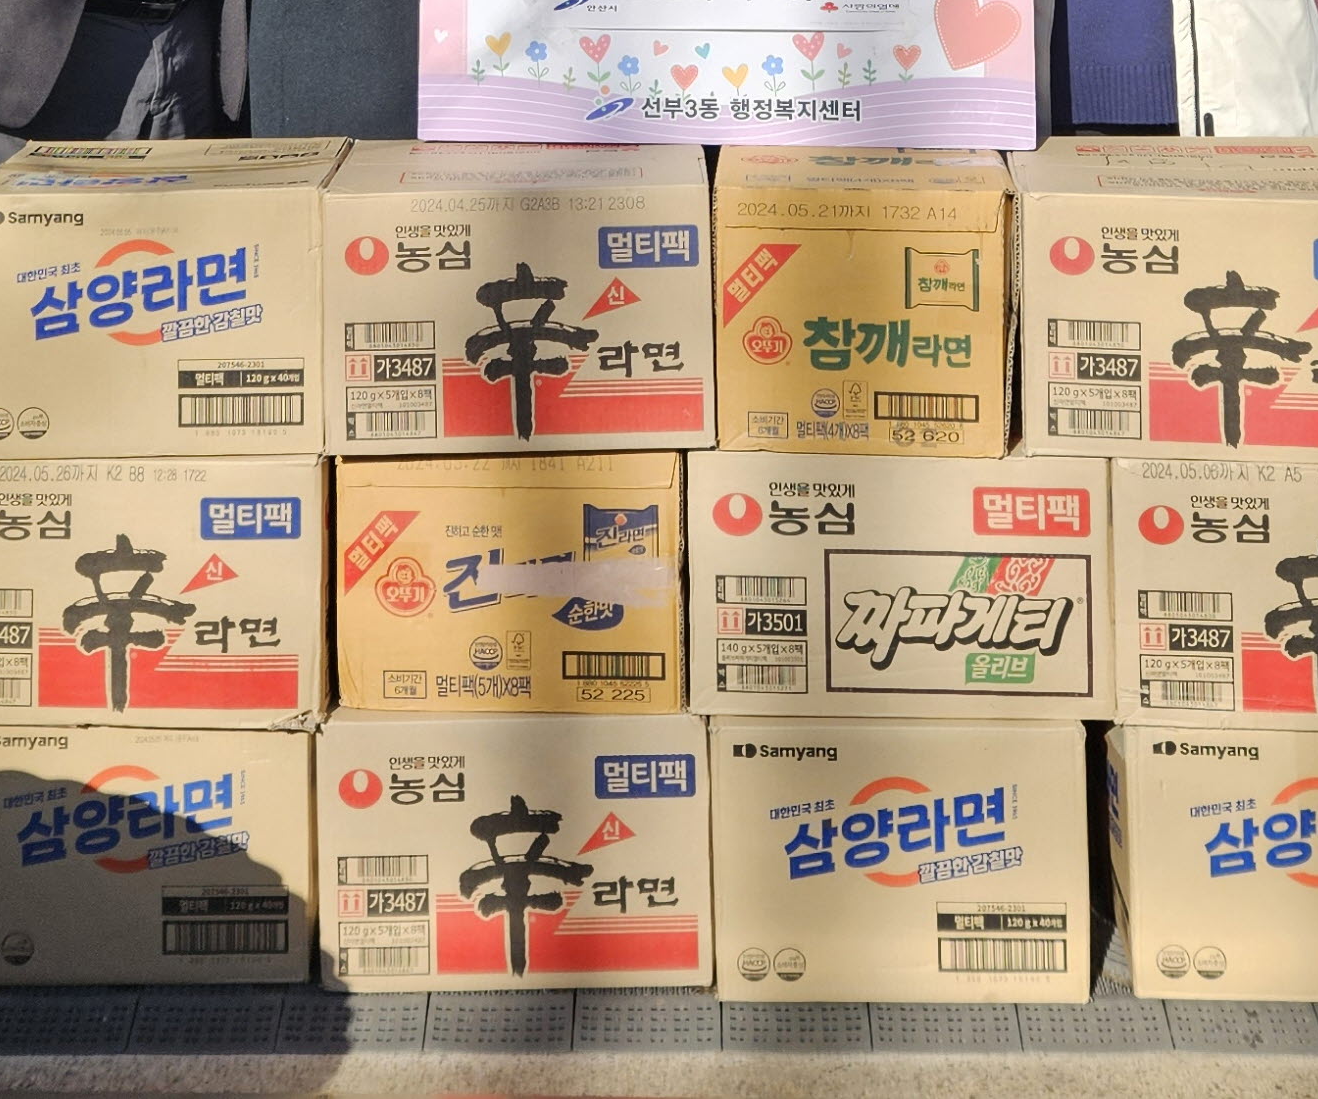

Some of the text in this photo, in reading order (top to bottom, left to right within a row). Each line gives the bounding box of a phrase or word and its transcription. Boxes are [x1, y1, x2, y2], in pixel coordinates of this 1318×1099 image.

[641, 97, 862, 123] 선부3동 행정복지센터
[410, 195, 645, 213] 2024.04.25까지 2308
[737, 202, 957, 221] 2024.05.21까지 1732 A14
[8, 211, 84, 226] Samyang
[395, 224, 471, 238] 인생을 맛있게
[1101, 226, 1179, 242] 인생을 맛있게
[395, 240, 471, 272] 농심
[607, 230, 690, 263] 멀티팩
[1100, 243, 1179, 275] 농심
[17, 261, 81, 284] 대한민국 최초
[726, 247, 779, 303] 멀티팩
[30, 246, 247, 341] 삼양라면
[917, 276, 965, 293] 참깨라면
[606, 287, 625, 306] 신
[162, 303, 263, 342] 깔끔한 감칠맛
[464, 262, 684, 442] 辛 라면
[751, 339, 783, 353] 오뚜기
[802, 316, 972, 371] 참깨라면
[217, 361, 265, 369] 207546-2301
[376, 358, 433, 379] 가3487
[1080, 355, 1138, 377] 가3487
[1171, 270, 1313, 449] 辛
[195, 373, 224, 386] 멀티팩
[892, 430, 960, 443] 52 620
[0, 465, 97, 482] 2024.05.26까지
[107, 465, 123, 481] K2
[1258, 466, 1275, 482] K2
[1284, 467, 1302, 483] A5
[36, 493, 72, 506] 맛있게
[768, 481, 855, 498] 인생을 맛있게
[982, 493, 1080, 532] 멀티팩
[1190, 495, 1270, 510] 인생을 맛있게
[209, 504, 292, 535] 멀티팩
[768, 499, 855, 536] 농심
[1191, 511, 1270, 544] 농심
[348, 514, 399, 567] 멀티팩
[472, 525, 489, 538] 순한
[596, 524, 644, 549] 진라면
[205, 562, 223, 580] 신
[386, 585, 425, 603] 오뚜기
[62, 534, 281, 713] 辛 라면
[567, 601, 614, 626] 순한맛
[748, 612, 803, 632] 가3501
[835, 586, 1075, 671] 짜파게티
[1172, 627, 1230, 648] 가3487
[970, 654, 1027, 679] 올리브
[387, 674, 422, 683] 소비기간
[395, 685, 417, 695] 6개월
[581, 689, 645, 701] 52 225
[760, 744, 837, 761] Samyang
[1180, 742, 1259, 760] Samyang
[389, 755, 465, 769] 인생을 맛있게
[603, 760, 687, 793] 멀티팩
[389, 772, 466, 805] 농심
[770, 799, 835, 820] 대한민국 최초
[1190, 798, 1256, 818] 대한민국 최초
[16, 773, 233, 867] 삼양라면
[602, 822, 620, 841] 신
[784, 786, 1005, 880] 삼양라면
[919, 846, 1023, 885] 깔끔한 감칠맛
[459, 795, 679, 978] 辛 라면
[369, 891, 426, 914] 가3487
